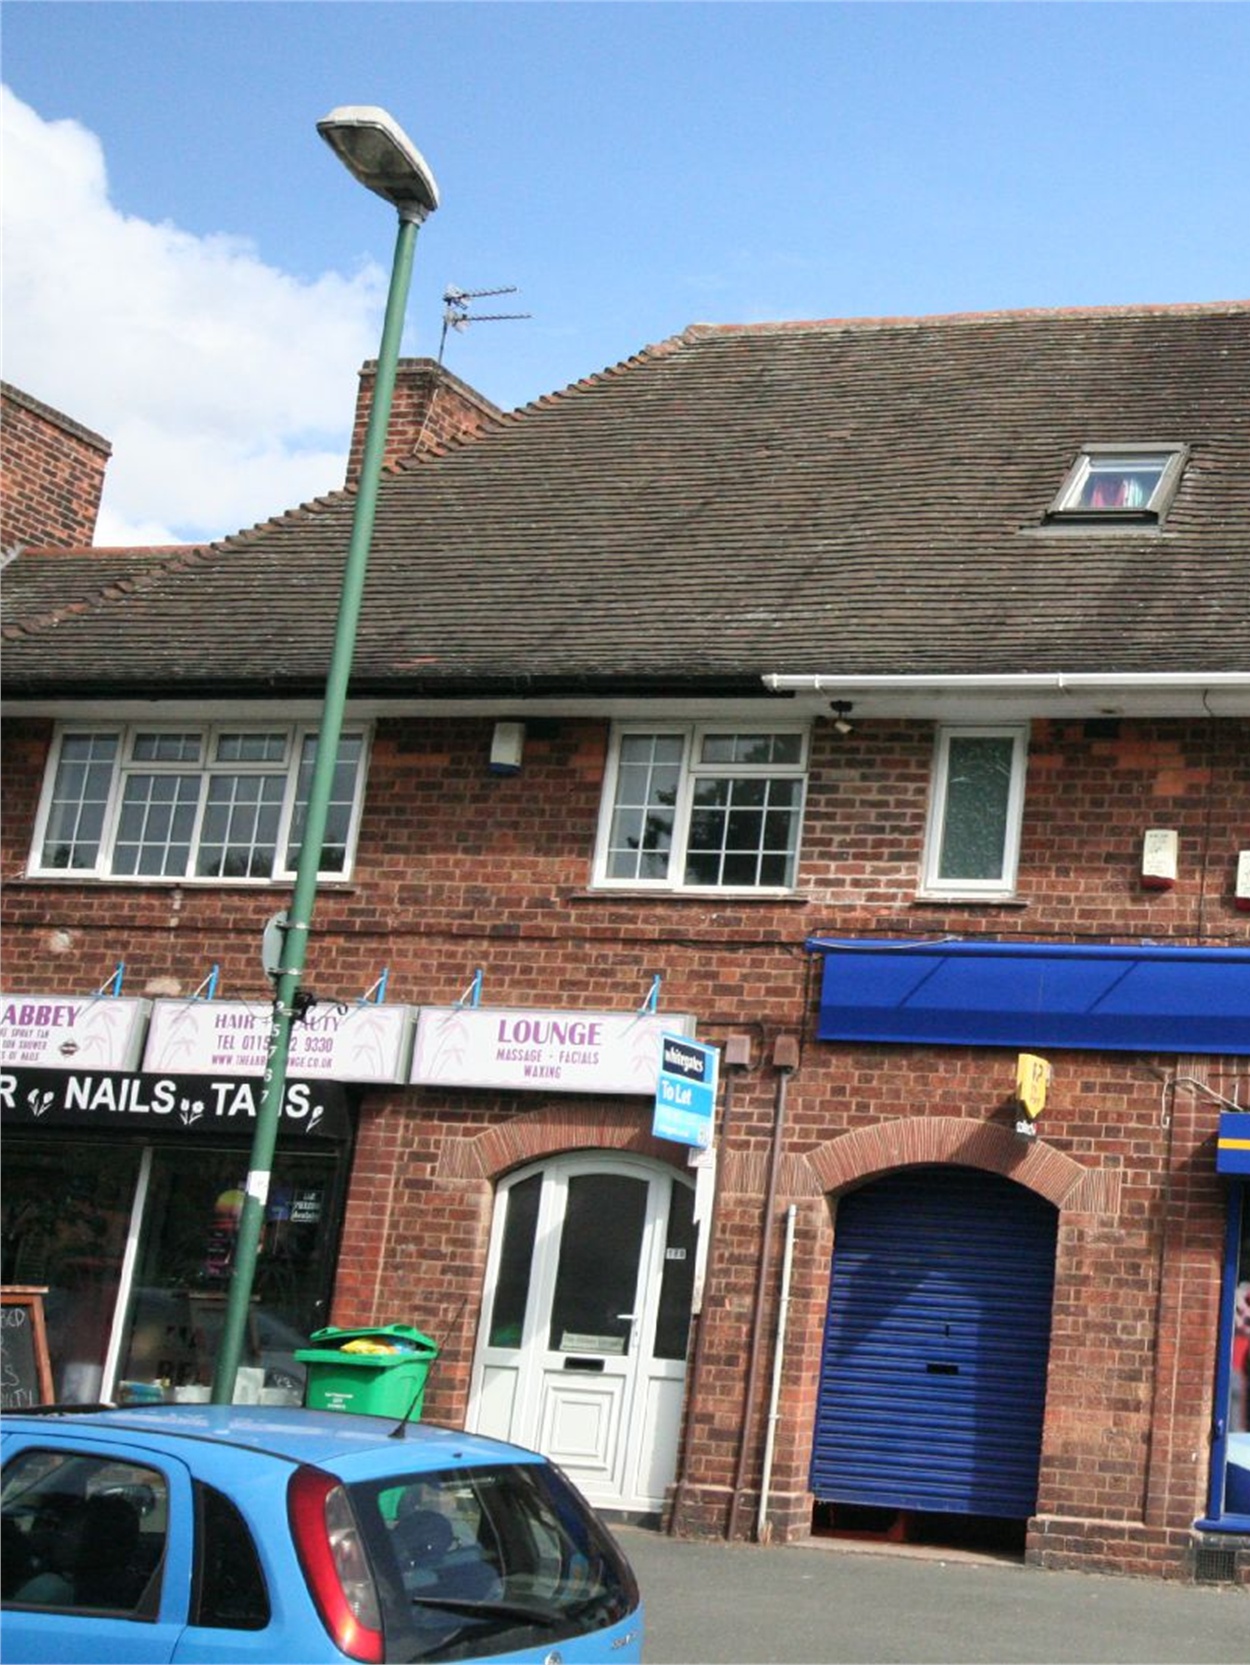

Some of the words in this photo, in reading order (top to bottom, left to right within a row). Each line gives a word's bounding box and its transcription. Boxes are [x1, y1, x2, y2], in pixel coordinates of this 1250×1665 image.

[1, 1004, 82, 1027] ABBEY
[215, 1014, 254, 1029] HAIR
[217, 1035, 235, 1050] TEL
[304, 1037, 333, 1052] 9330
[498, 1020, 604, 1046] LOUNGE
[496, 1048, 542, 1062] MASSAGE
[559, 1051, 599, 1065] FACIALS
[524, 1065, 561, 1079] WAXING
[64, 1076, 176, 1114] NAILS
[210, 1083, 311, 1119] TAS
[662, 1081, 674, 1100] To
[675, 1084, 692, 1105] Let
